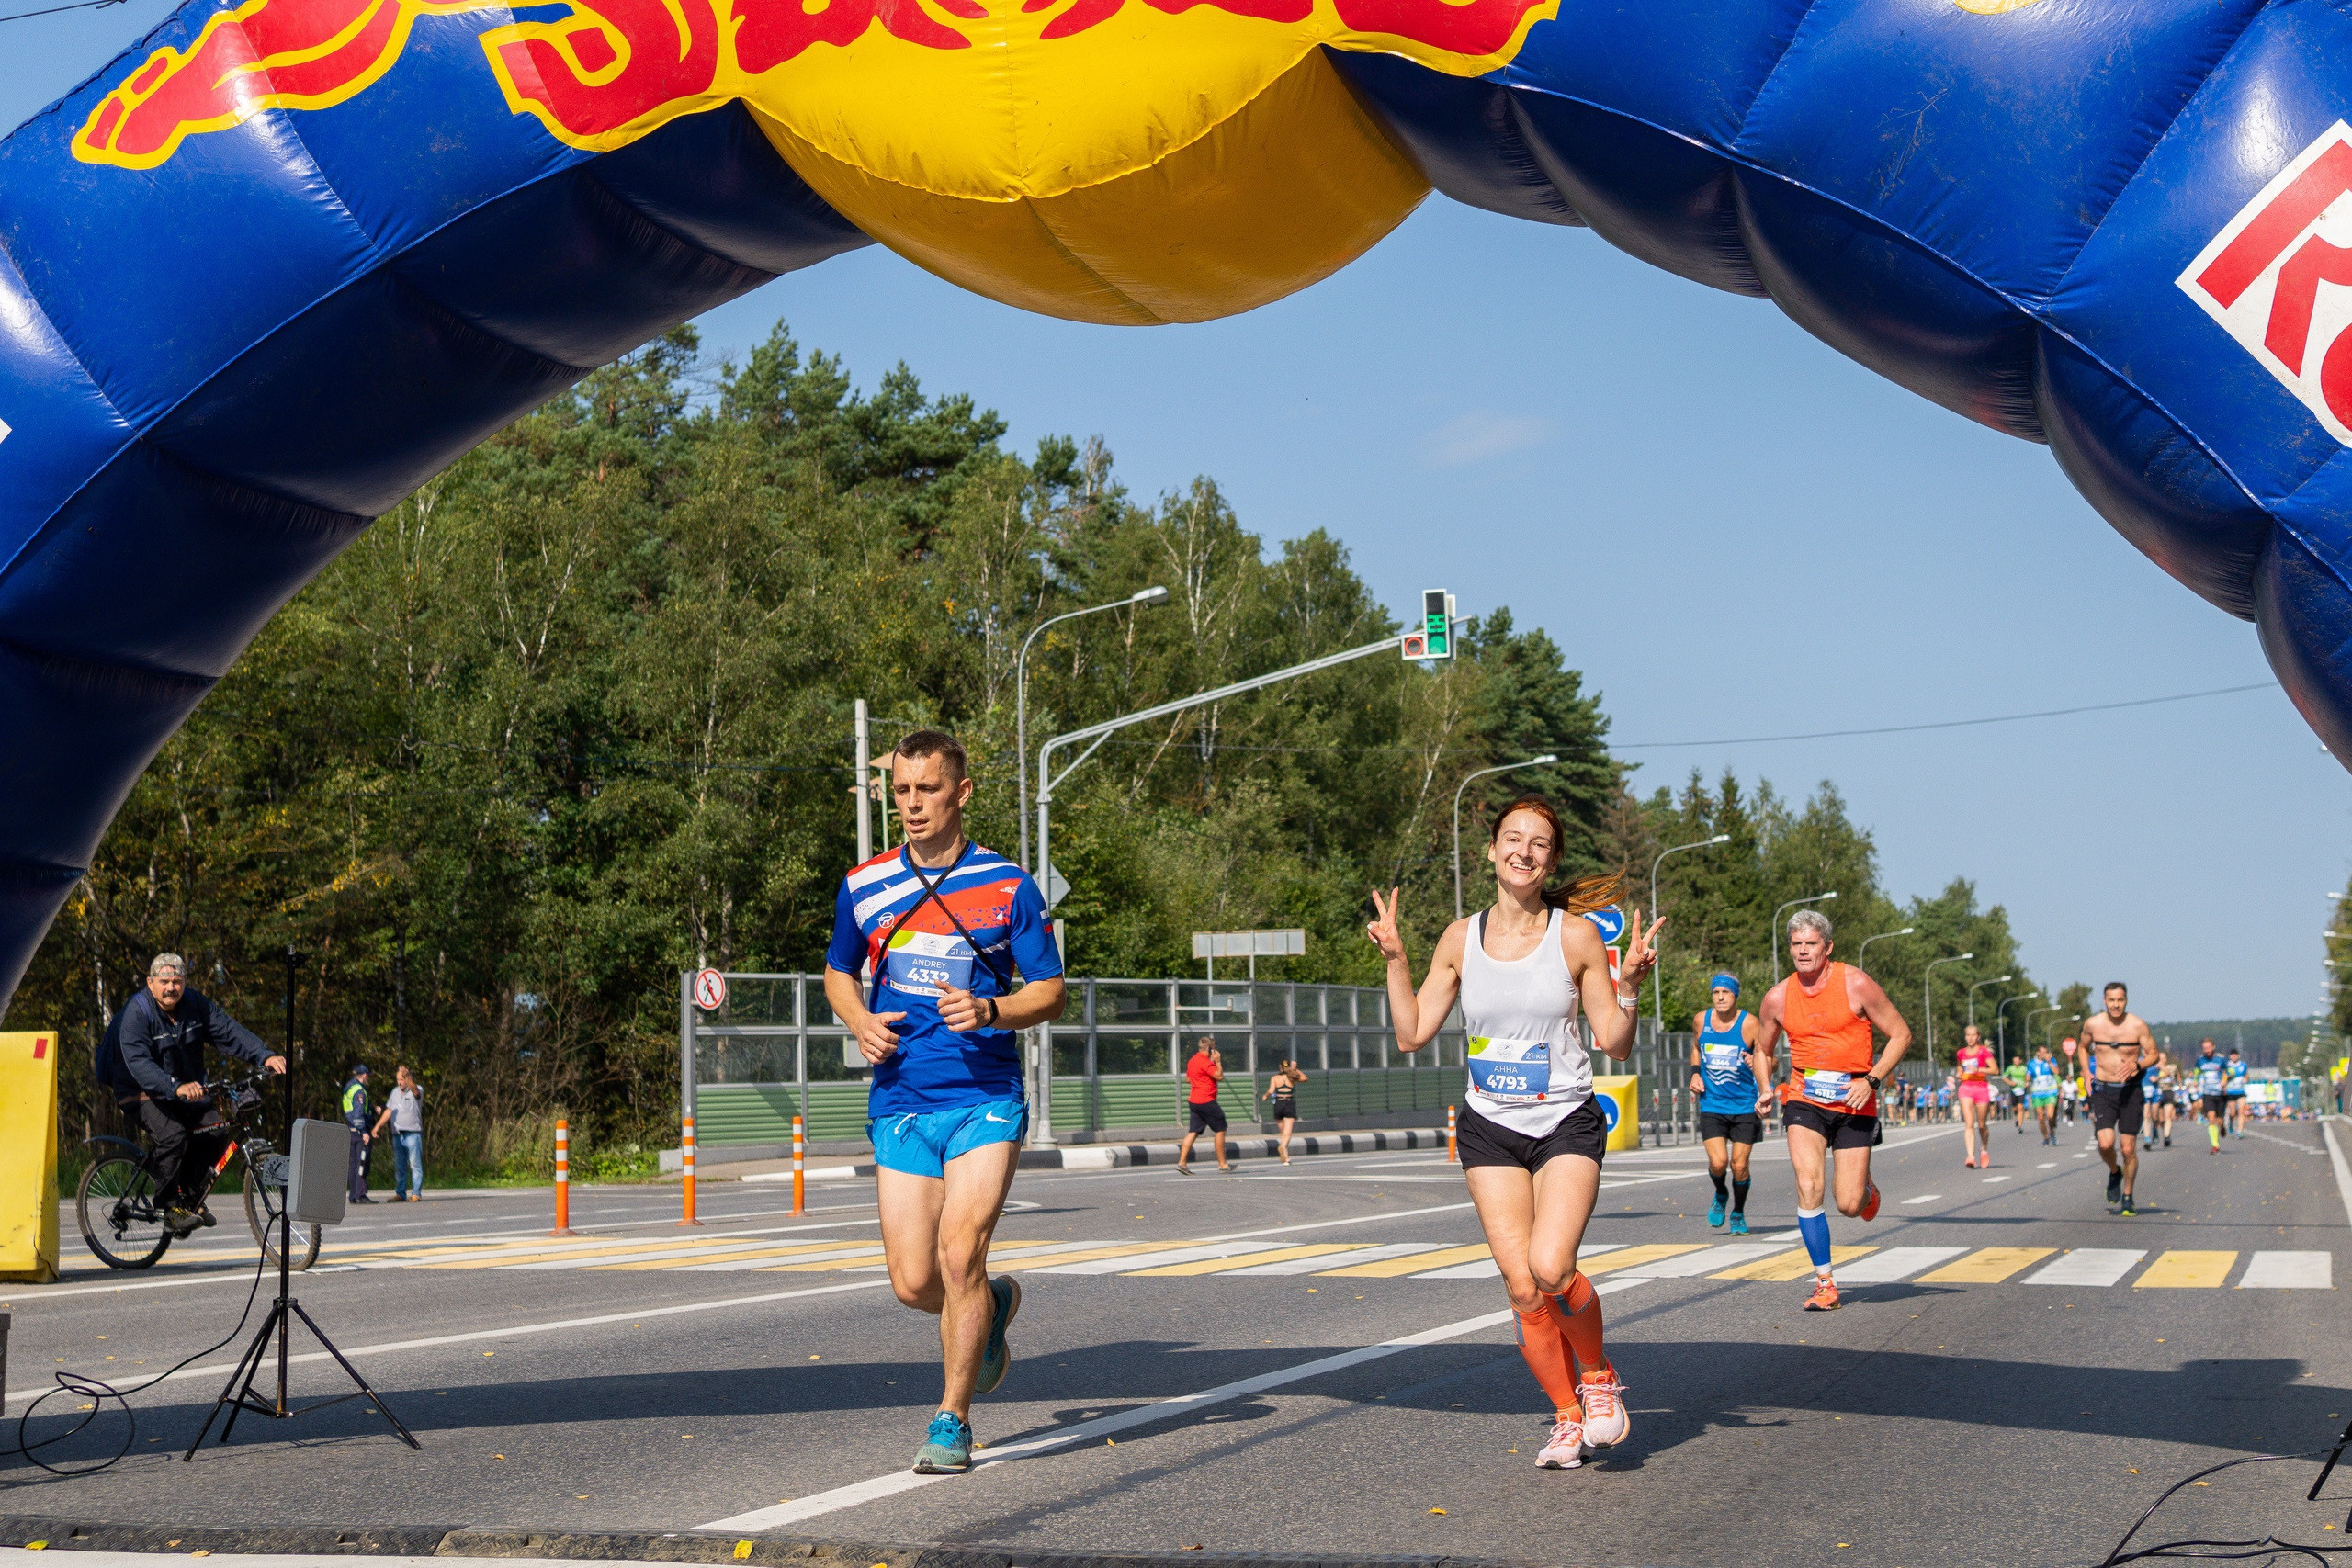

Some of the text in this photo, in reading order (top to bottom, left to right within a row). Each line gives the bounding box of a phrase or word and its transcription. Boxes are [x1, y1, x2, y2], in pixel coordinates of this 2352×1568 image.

[950, 948, 959, 956] 21
[912, 958, 947, 969] ANDREY
[906, 967, 950, 985] 4332
[1525, 1052, 1534, 1060] 21
[1493, 1065, 1519, 1074] АННА
[1486, 1074, 1528, 1091] 4793
[1815, 1088, 1837, 1100] 6113
